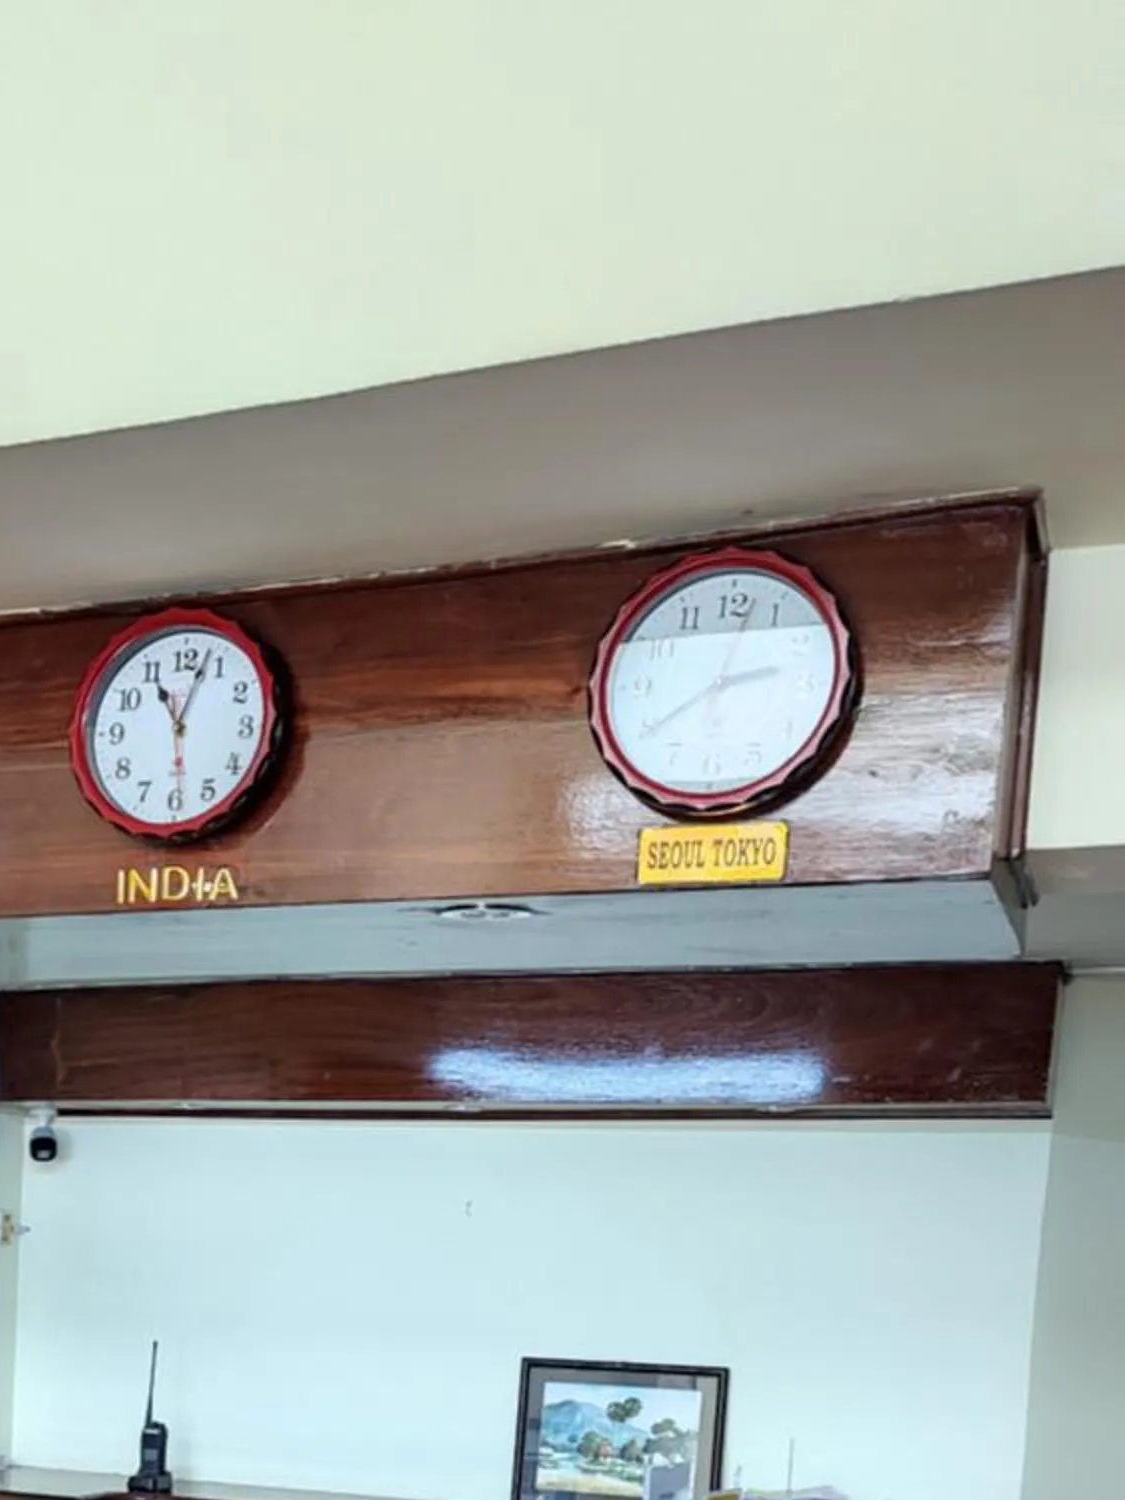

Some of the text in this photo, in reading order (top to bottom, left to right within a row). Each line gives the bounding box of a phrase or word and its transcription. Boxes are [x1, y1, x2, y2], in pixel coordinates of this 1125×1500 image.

[718, 593, 747, 619] 12
[770, 603, 780, 627] 1
[679, 607, 699, 630] 11
[650, 639, 674, 658] 10
[174, 649, 198, 672] 12
[144, 662, 160, 683] 11
[119, 688, 141, 711] 10
[233, 682, 248, 704] 2
[109, 722, 125, 745] 9
[238, 715, 254, 738] 3
[116, 757, 131, 779] 8
[225, 753, 241, 775] 4
[137, 781, 152, 802] 7
[168, 788, 183, 811] 6
[201, 779, 216, 801] 5
[647, 838, 775, 870] SEOUL TOKYO
[117, 866, 238, 904] INDIA
